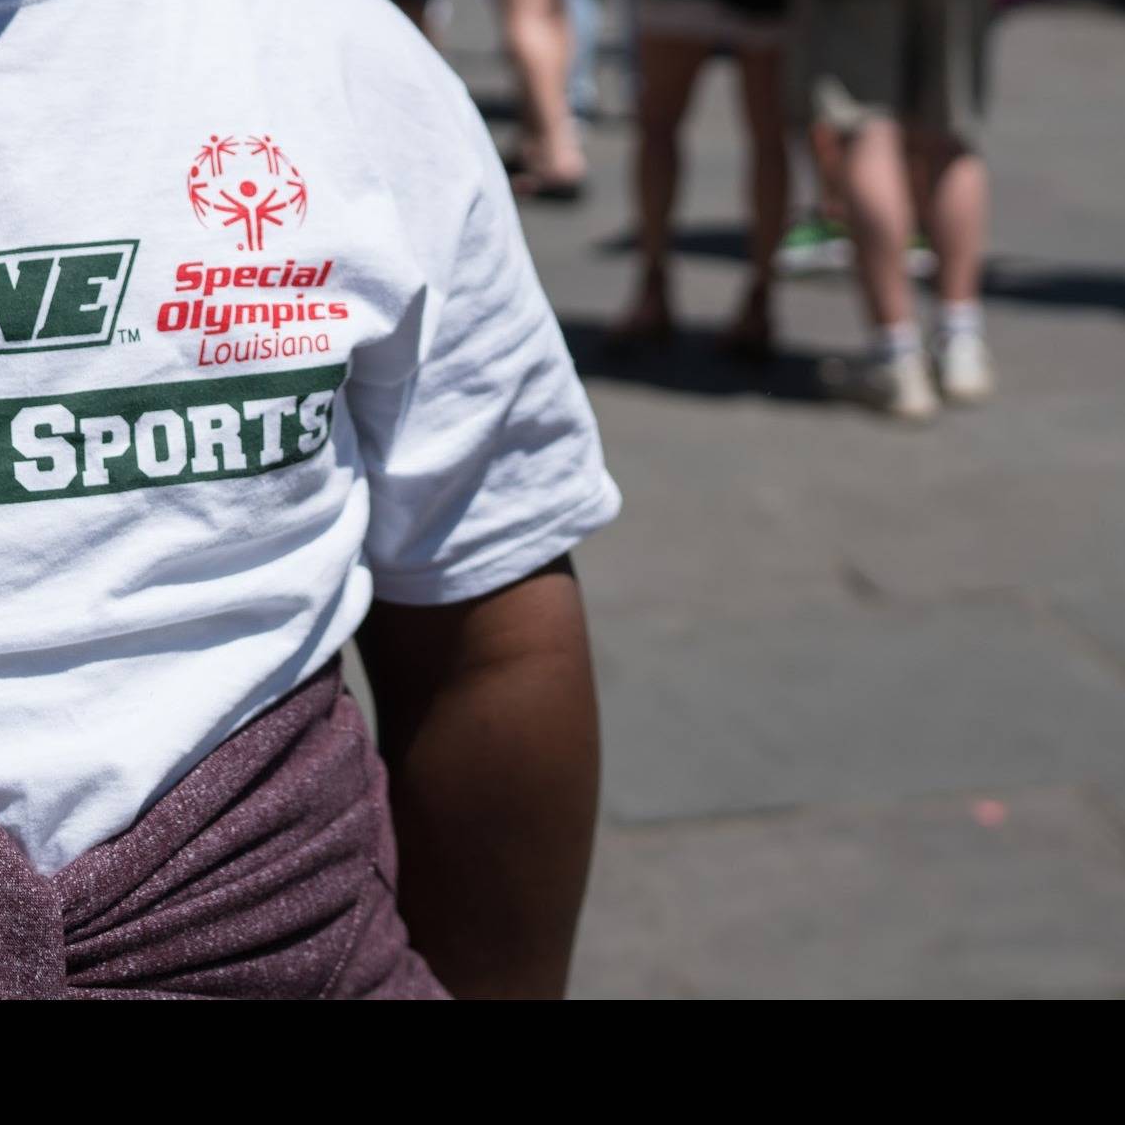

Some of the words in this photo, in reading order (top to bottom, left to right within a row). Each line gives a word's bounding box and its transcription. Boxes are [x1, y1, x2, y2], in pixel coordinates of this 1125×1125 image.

[175, 259, 333, 296] Special
[156, 293, 349, 336] Olympics
[197, 332, 331, 367] Louisiana
[10, 389, 335, 492] SPORTS
